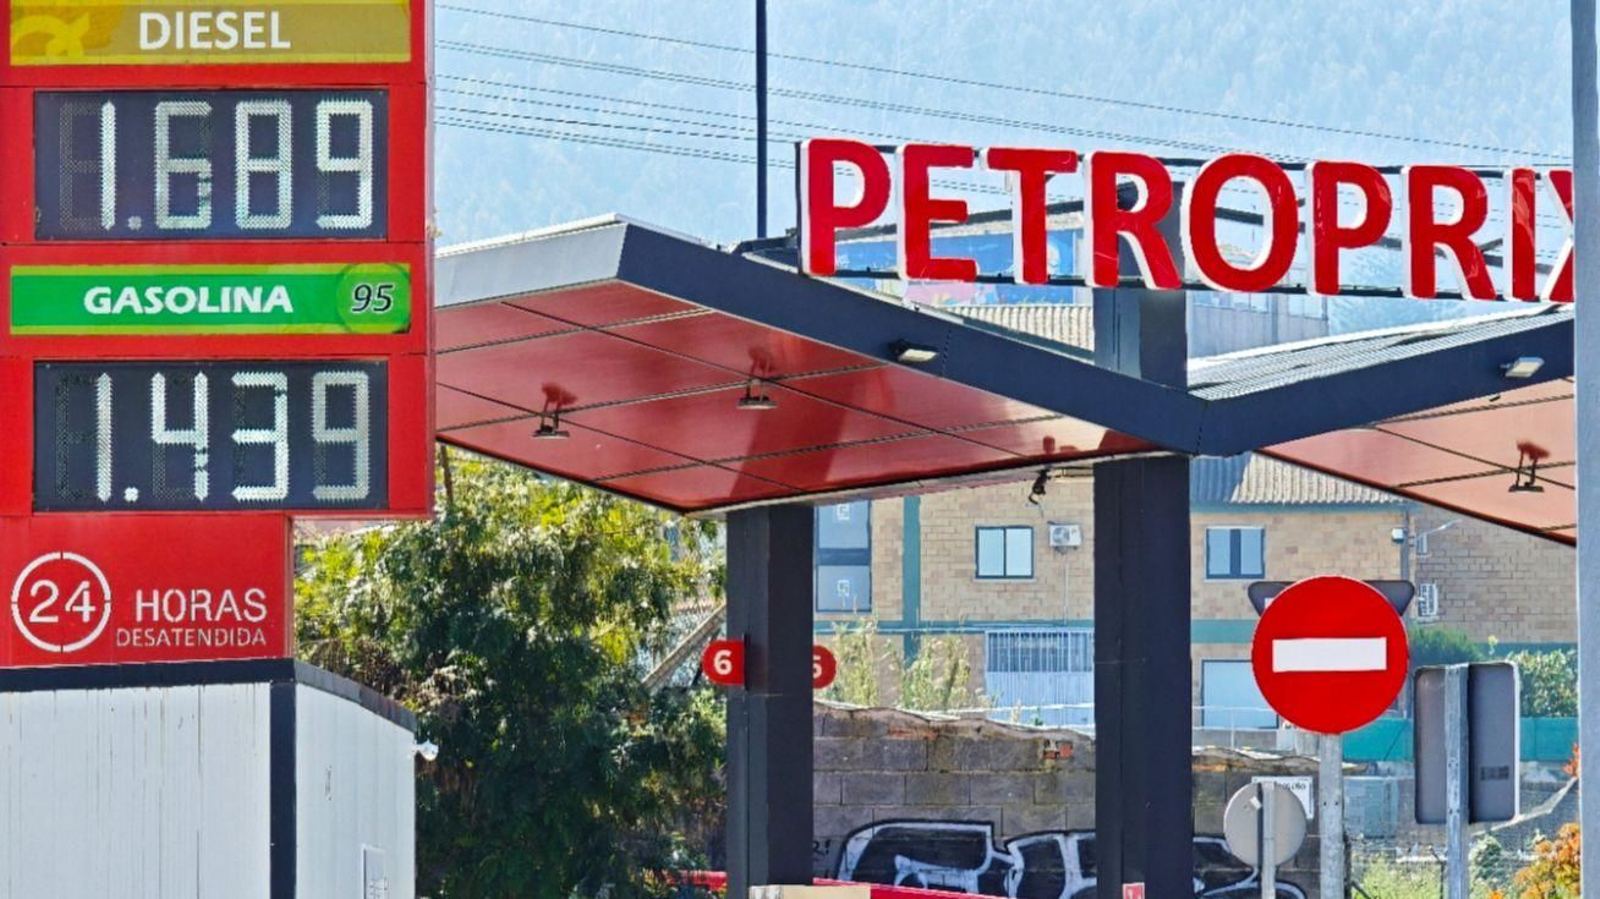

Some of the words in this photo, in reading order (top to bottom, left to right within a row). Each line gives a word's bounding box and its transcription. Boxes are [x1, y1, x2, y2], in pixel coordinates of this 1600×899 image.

[138, 10, 291, 51] DIESEL
[100, 99, 374, 231] 1.689
[83, 285, 294, 315] GASOLINA
[351, 283, 394, 313] 95
[96, 370, 371, 503] 1.439
[28, 579, 97, 624] 24
[135, 587, 268, 623] HORAS
[115, 627, 267, 648] DESATENDIDA
[713, 649, 733, 676] 6
